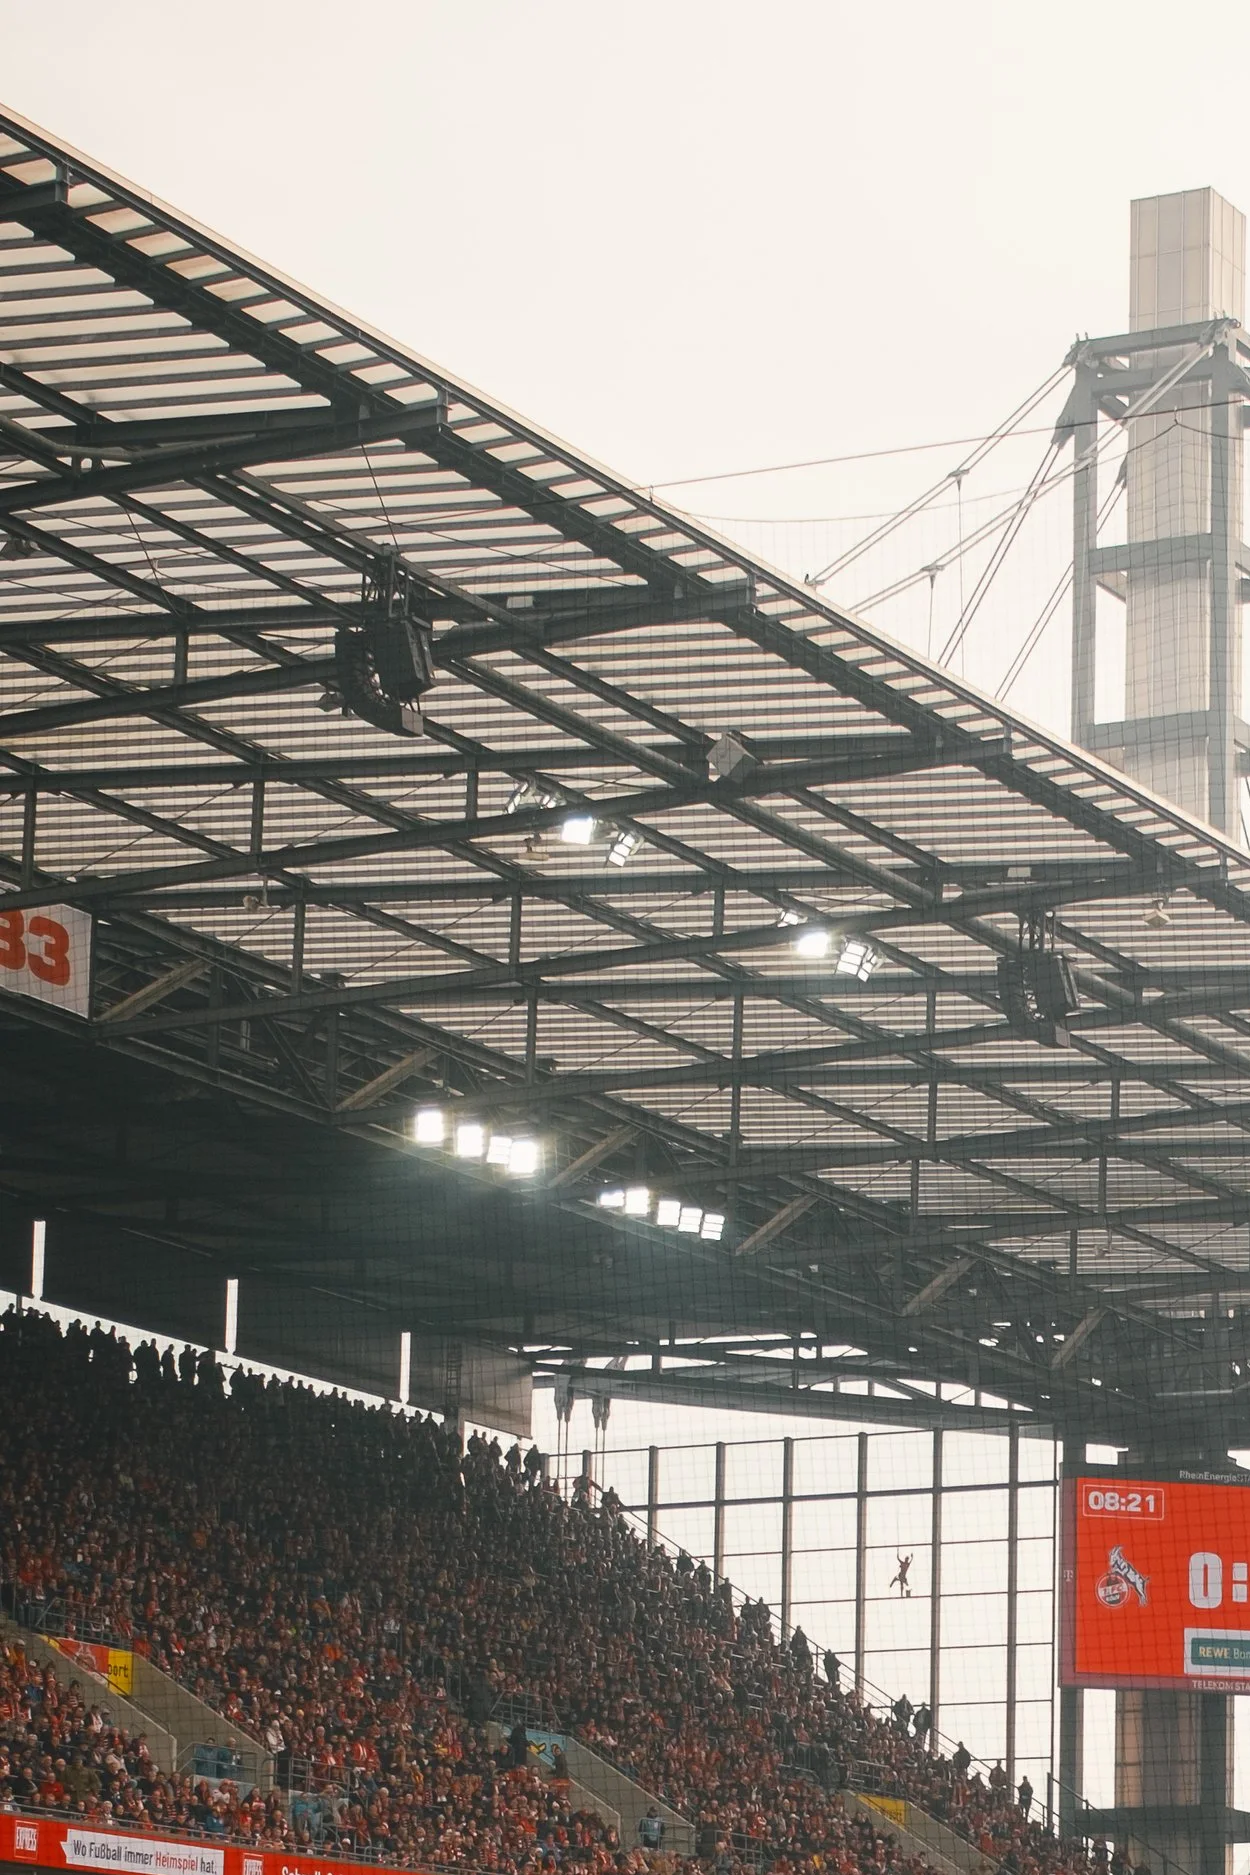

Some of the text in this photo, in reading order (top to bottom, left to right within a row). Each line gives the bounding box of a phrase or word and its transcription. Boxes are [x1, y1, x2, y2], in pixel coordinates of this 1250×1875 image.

[1088, 1491, 1155, 1512] 08:21
[1199, 1646, 1231, 1659] REWE
[1192, 1680, 1233, 1691] TELEKOM
[73, 1839, 87, 1857] Wo
[89, 1842, 123, 1862] Fußball
[124, 1847, 153, 1866] immer
[200, 1859, 217, 1874] hat.
